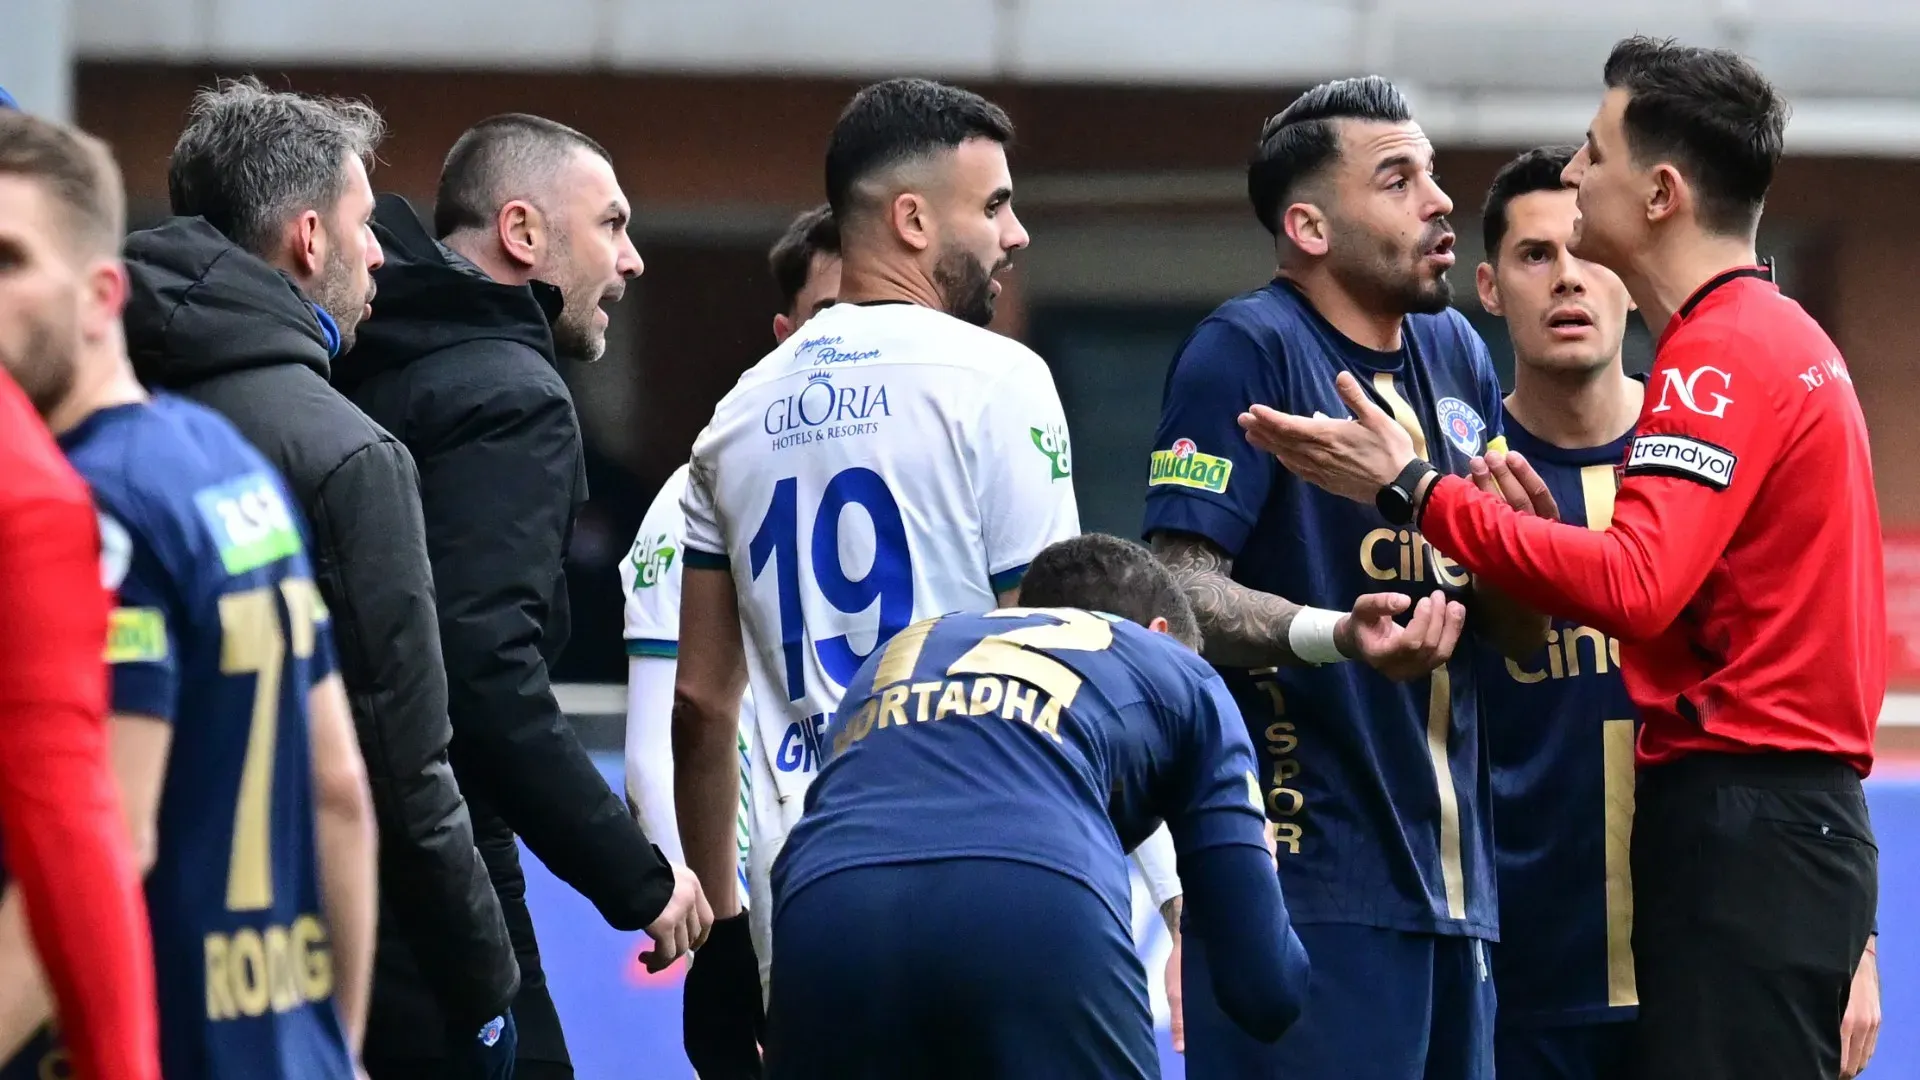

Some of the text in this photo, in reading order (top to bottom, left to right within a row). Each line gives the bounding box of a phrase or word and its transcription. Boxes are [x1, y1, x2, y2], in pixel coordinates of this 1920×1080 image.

[764, 381, 892, 435] GLORIA
[1652, 365, 1734, 418] NG
[772, 422, 879, 451] HOTELS & RESORTS
[1634, 441, 1732, 478] trendyol
[1151, 451, 1226, 491] uludağ
[749, 467, 914, 702] 19
[872, 607, 1113, 709] 12
